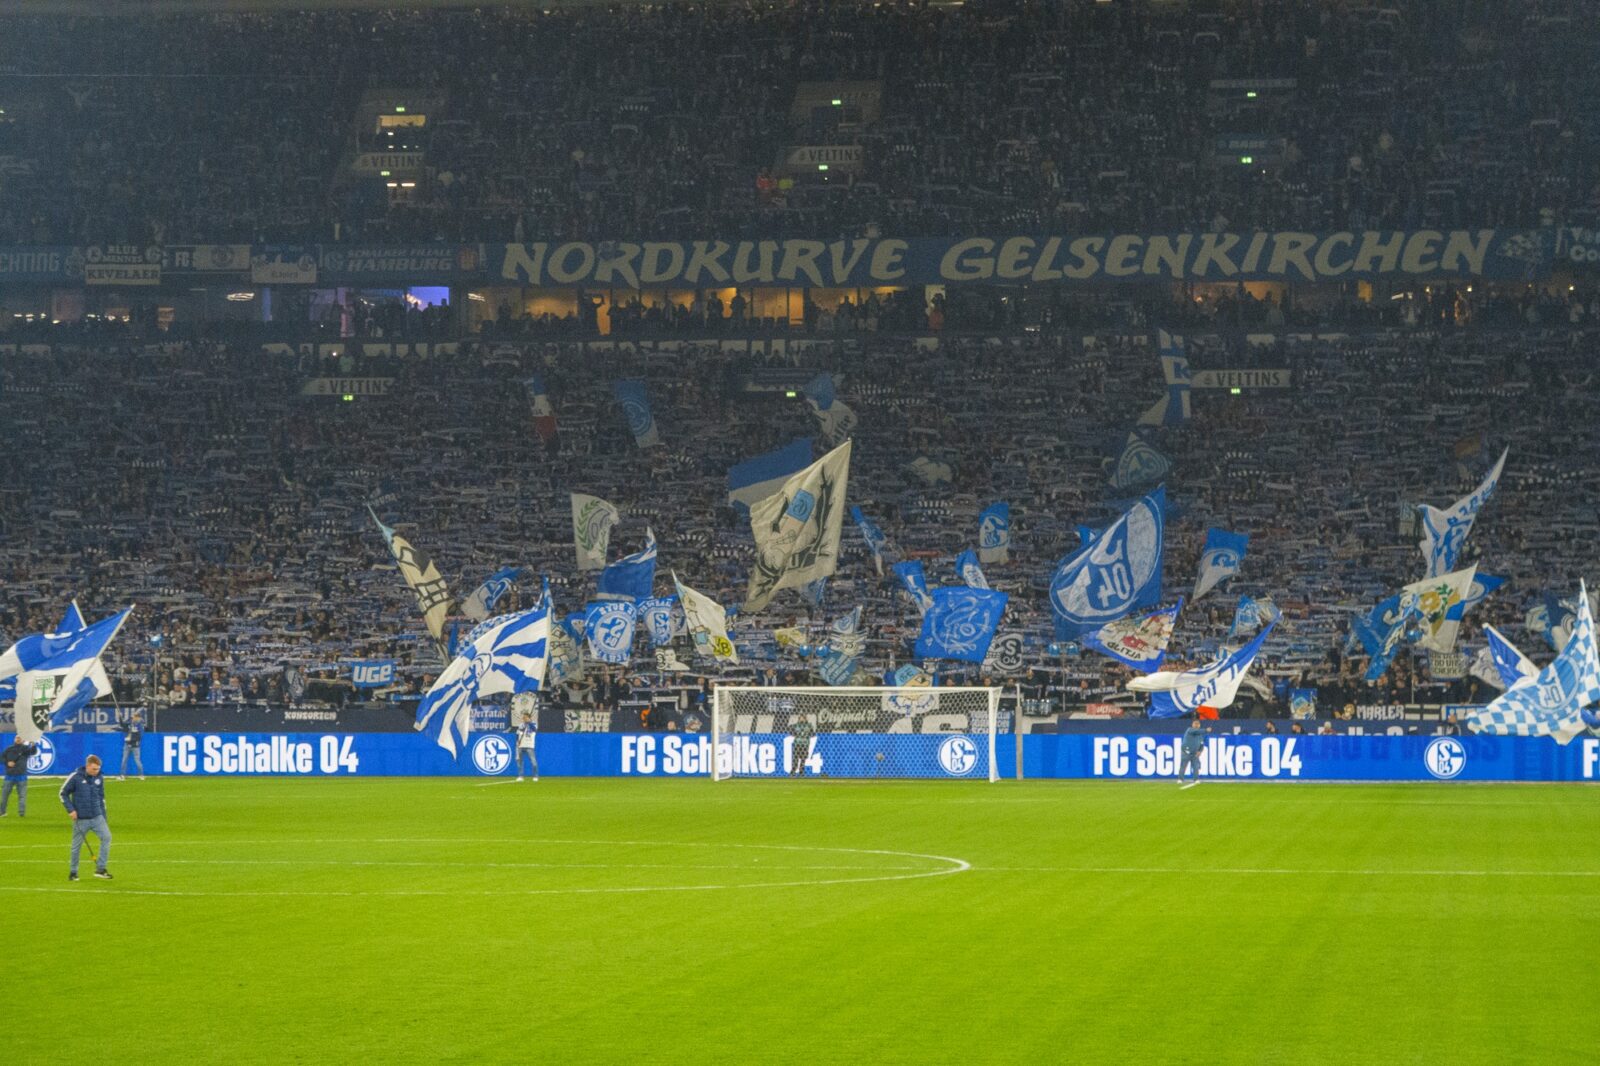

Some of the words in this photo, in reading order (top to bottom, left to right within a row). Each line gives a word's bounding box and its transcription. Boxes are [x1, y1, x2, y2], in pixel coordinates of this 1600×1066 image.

[809, 149, 860, 161] VELTINS
[347, 258, 453, 272] HAMBURG
[501, 240, 909, 289] NORDKURVE
[939, 229, 1494, 282] GELSENKIRCHEN
[87, 269, 160, 280] KEVELAER
[329, 379, 391, 394] VELTINS
[1215, 371, 1281, 386] VELTINS
[1356, 704, 1405, 721] MARLER
[163, 736, 196, 773] FC
[204, 736, 313, 773] Schalke
[320, 736, 359, 773] 04
[621, 736, 656, 773] FC
[664, 736, 776, 774] Schalke
[1094, 737, 1129, 775] FC
[1261, 737, 1302, 776] 04
[1583, 739, 1600, 778] F
